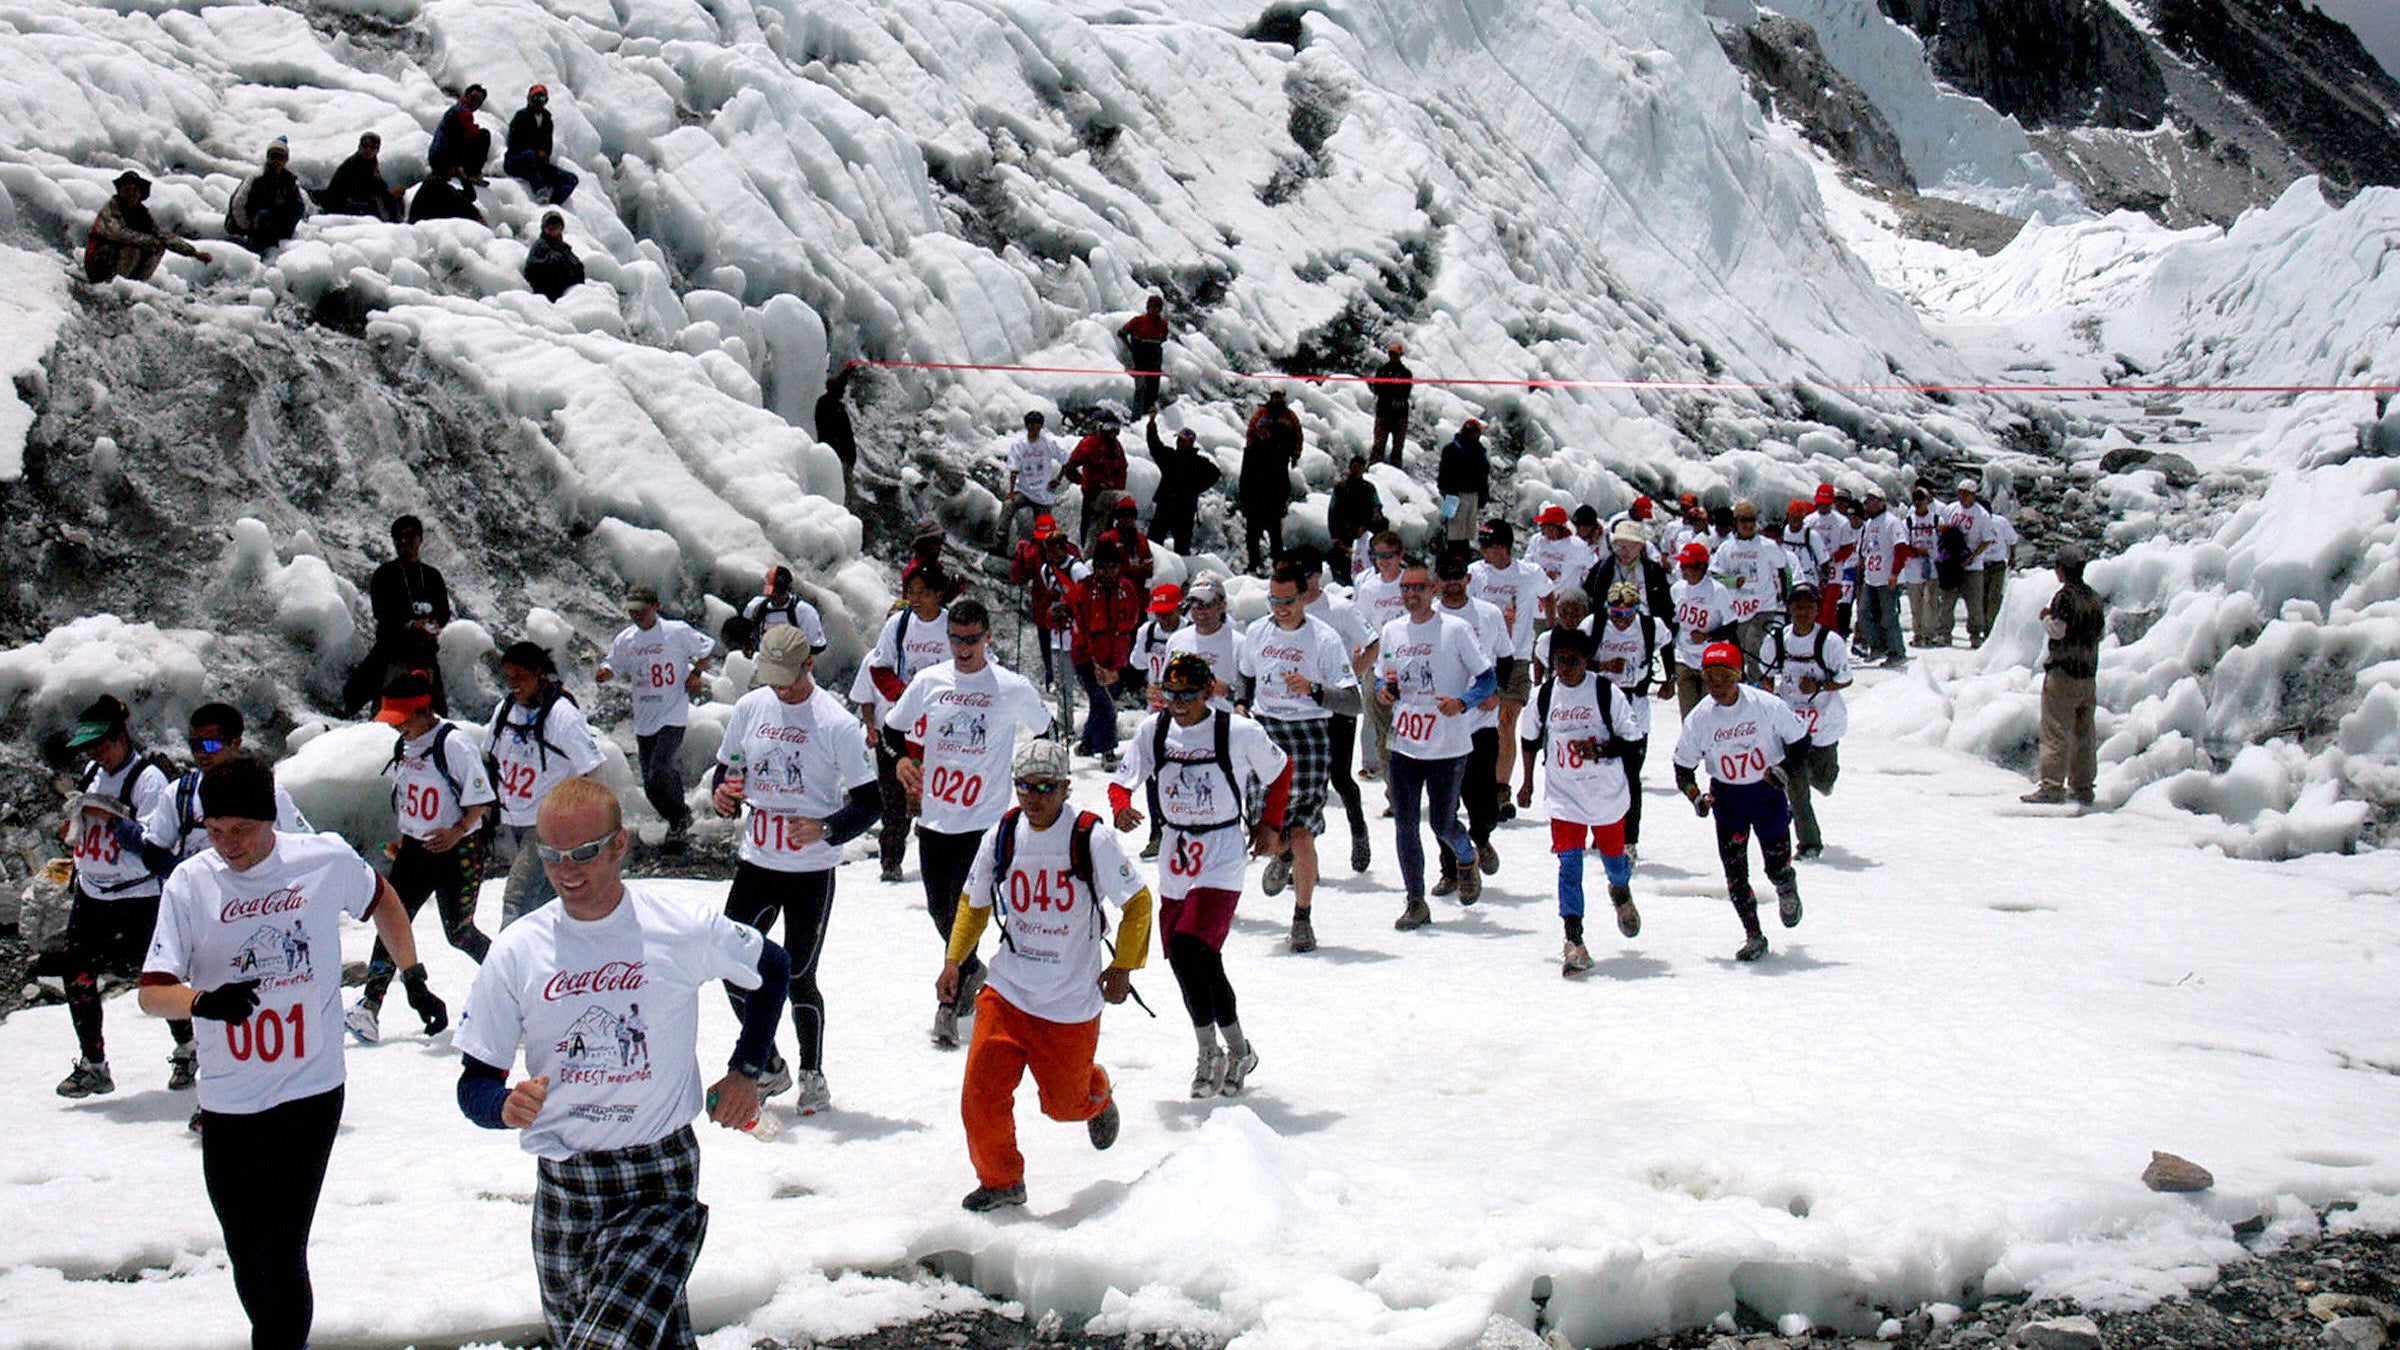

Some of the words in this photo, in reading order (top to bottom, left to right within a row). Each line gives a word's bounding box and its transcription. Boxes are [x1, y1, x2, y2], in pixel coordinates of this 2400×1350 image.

[1680, 603, 1708, 628] 058
[1262, 645, 1304, 662] Coca-Cola
[1395, 643, 1434, 659] Coca-Cola
[651, 662, 675, 688] 83
[939, 690, 992, 707] Coca-Cola
[1397, 711, 1436, 740] 007
[1551, 706, 1593, 722] Coca-Cola
[756, 722, 809, 743] Coca-Cola
[1714, 721, 1757, 742] Coca-Cola
[1721, 748, 1766, 780] 070
[932, 766, 982, 807] 020
[220, 884, 308, 923] Coca-Cola
[1010, 869, 1075, 913] 045
[543, 961, 648, 1001] Coca-Cola
[226, 1003, 304, 1062] 001
